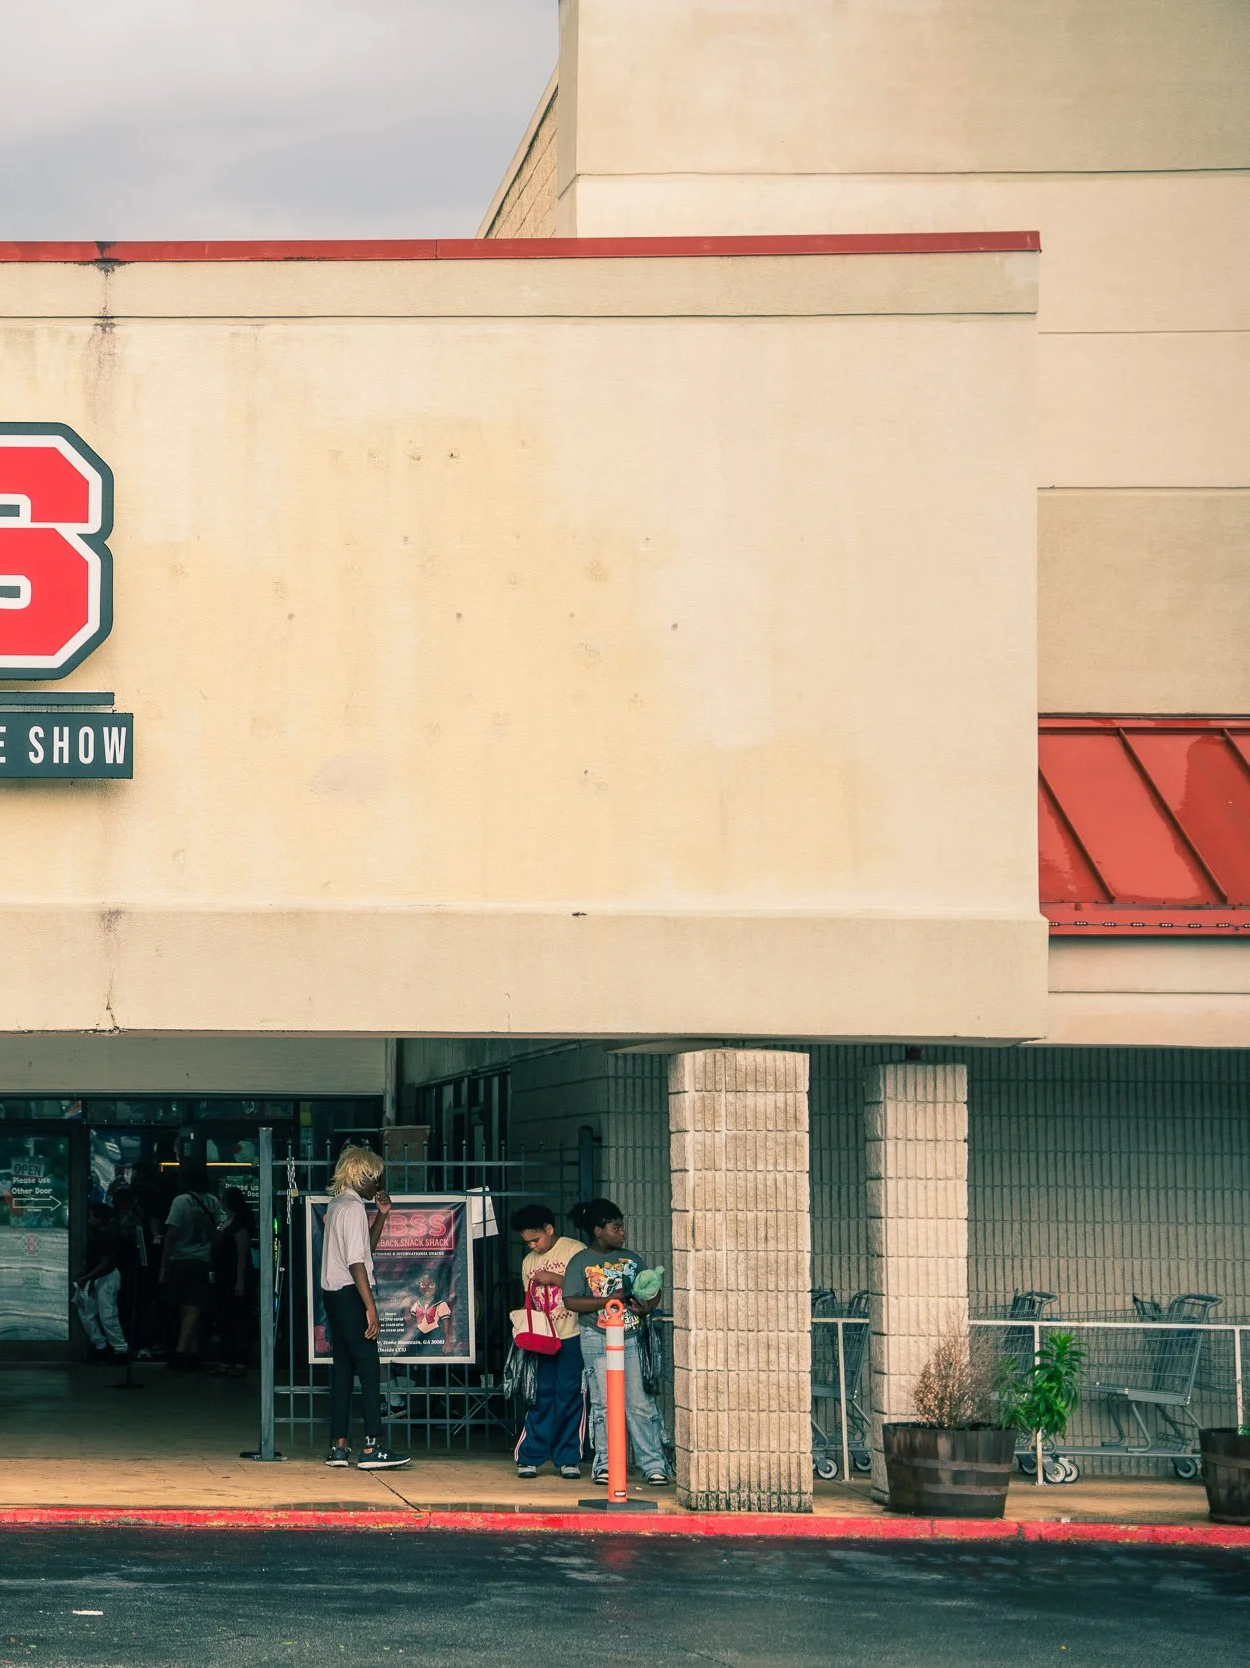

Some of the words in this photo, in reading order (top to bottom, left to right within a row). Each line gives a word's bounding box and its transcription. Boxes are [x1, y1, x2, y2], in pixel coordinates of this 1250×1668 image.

[28, 726, 128, 765] SHOW
[14, 1163, 42, 1177] OPEN
[380, 1239, 399, 1247] BACK
[401, 1239, 424, 1247] SNACK
[425, 1239, 449, 1247] SHACK
